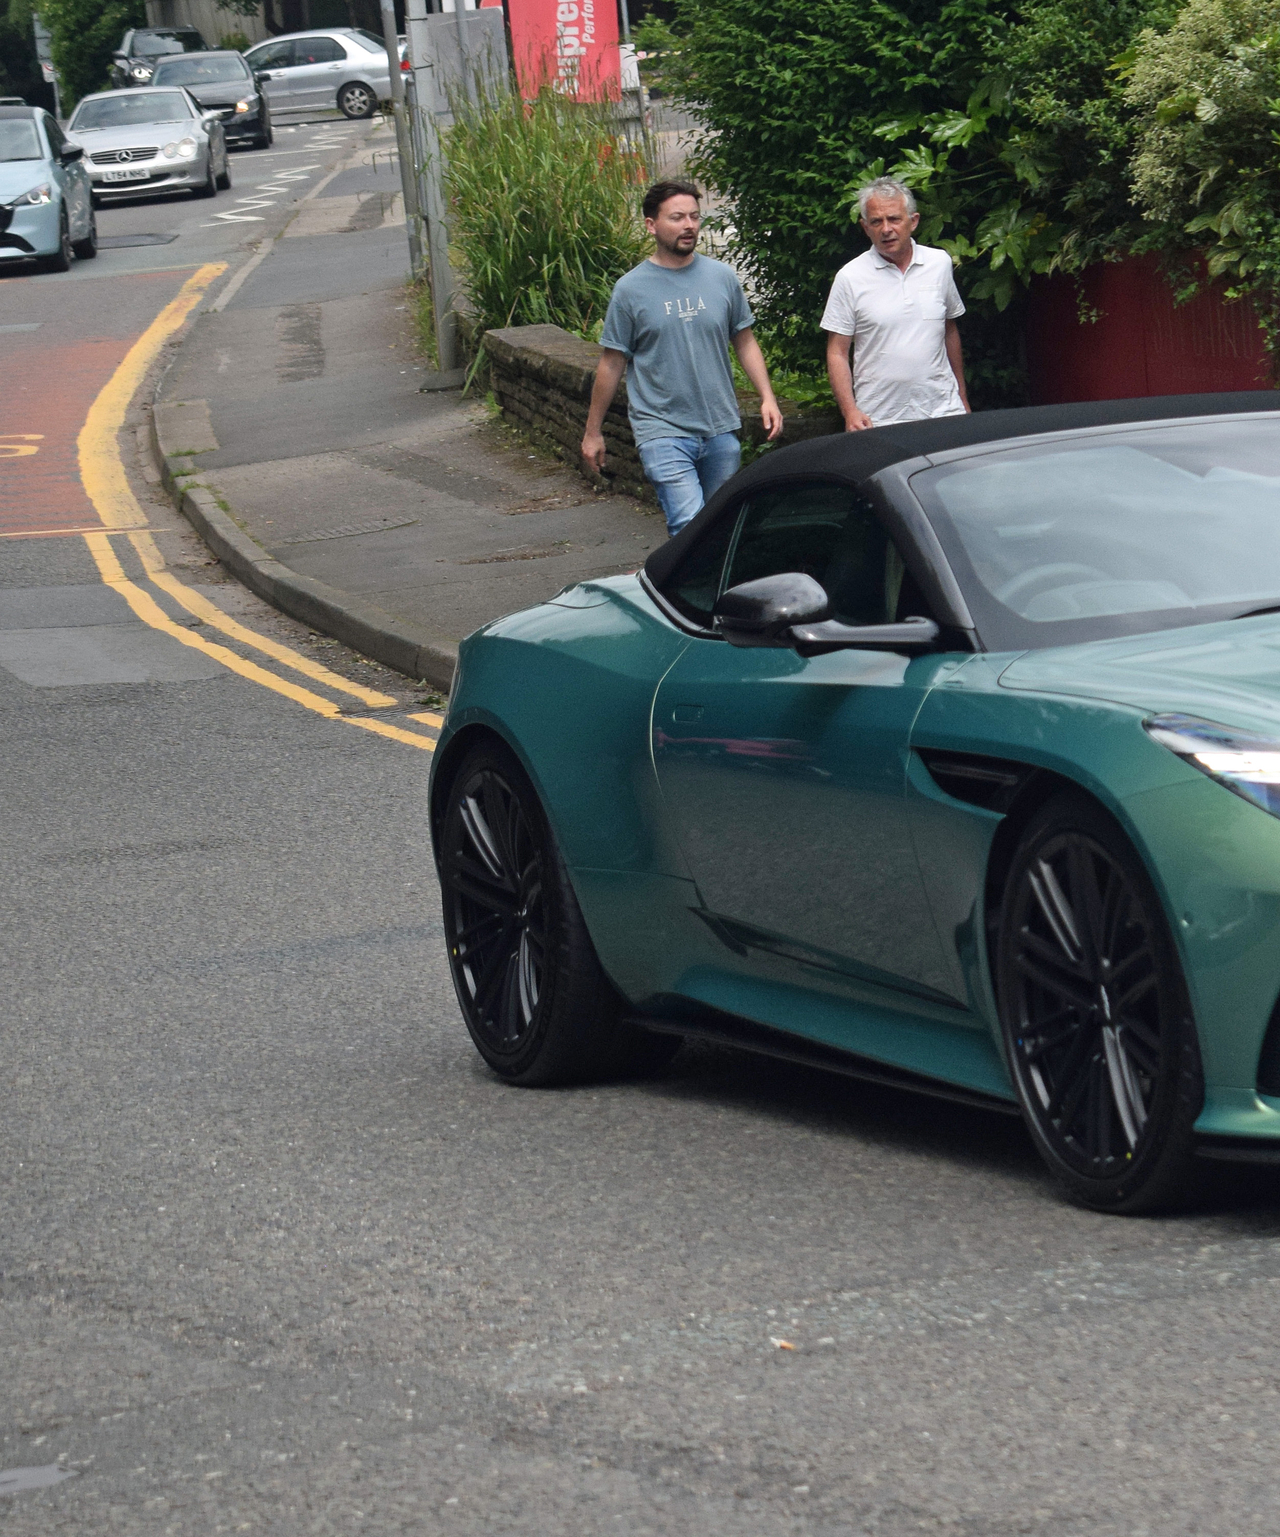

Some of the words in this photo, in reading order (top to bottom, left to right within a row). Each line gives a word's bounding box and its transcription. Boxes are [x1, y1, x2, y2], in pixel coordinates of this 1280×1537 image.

[553, 0, 587, 95] Supre
[105, 170, 127, 180] LT54
[664, 296, 706, 315] FILA
